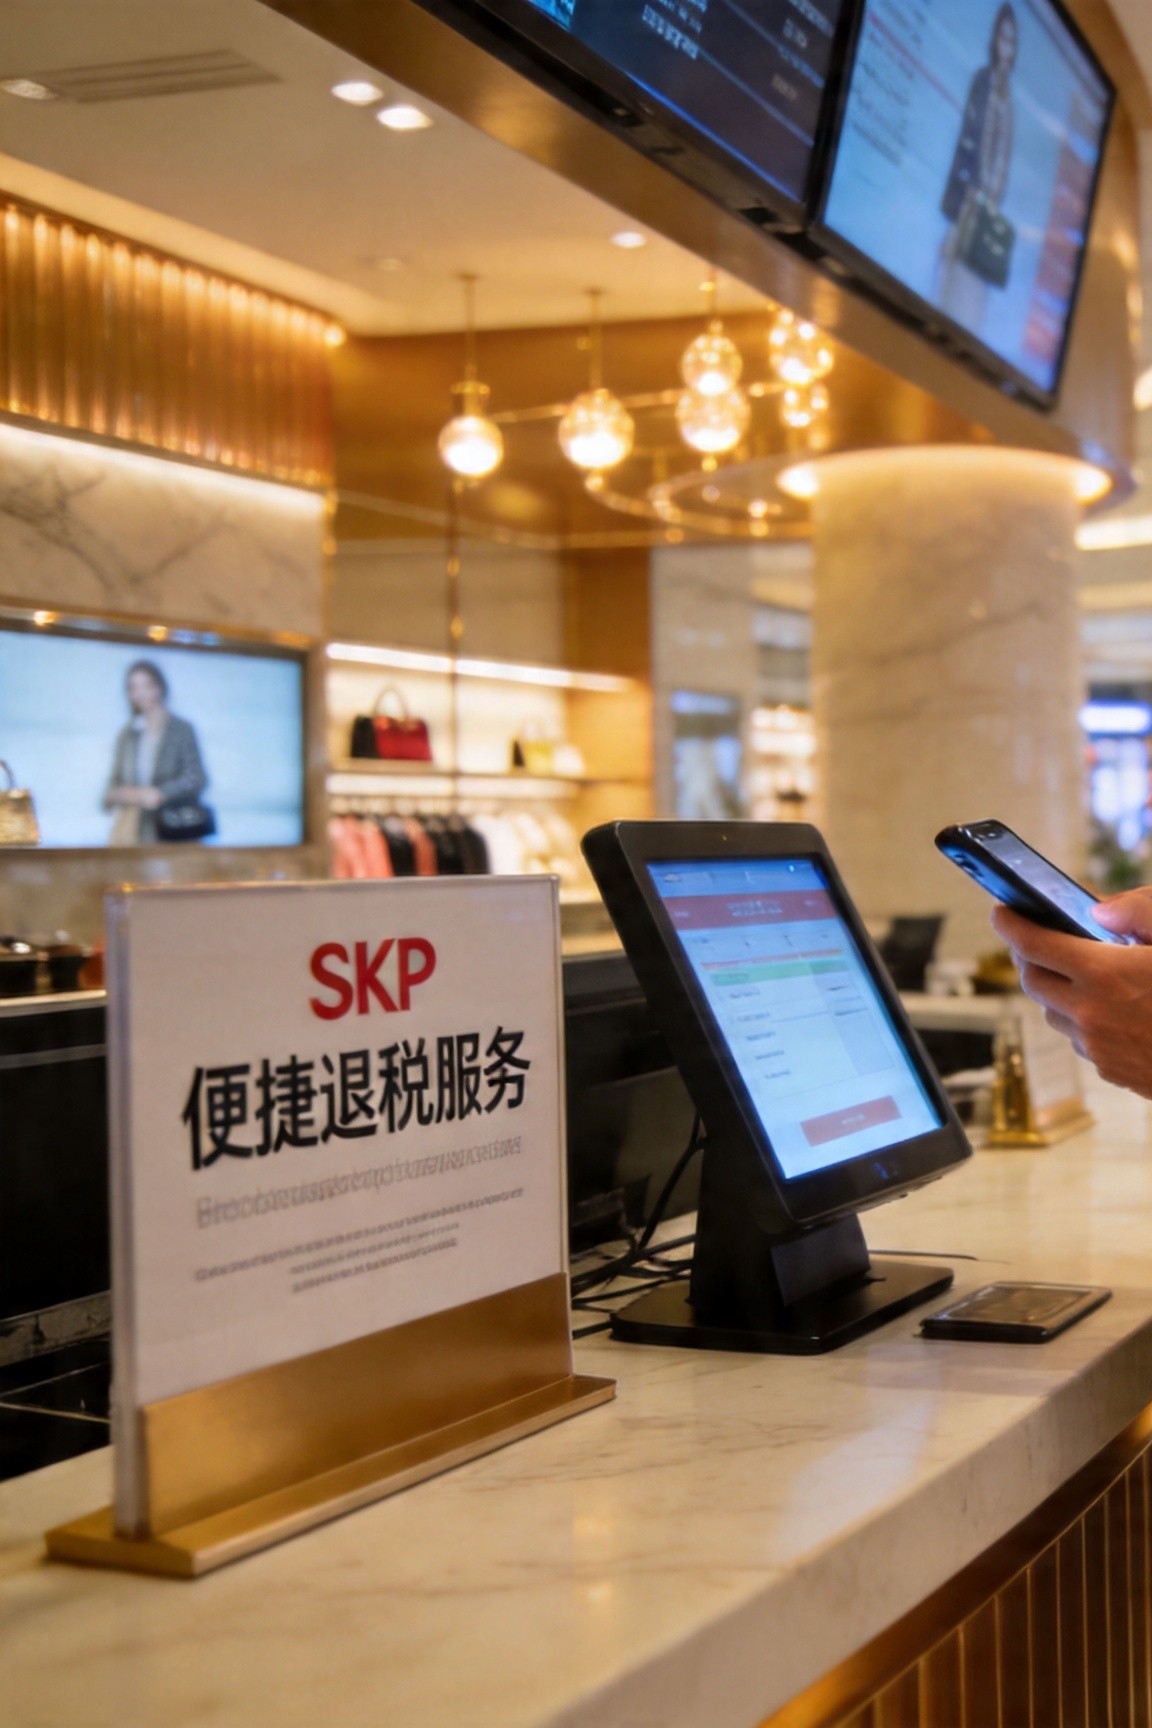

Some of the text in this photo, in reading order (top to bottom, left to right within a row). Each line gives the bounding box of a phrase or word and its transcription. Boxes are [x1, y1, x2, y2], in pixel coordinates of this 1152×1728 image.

[308, 937, 437, 1021] SKP
[182, 1026, 531, 1171] 便捷退税服务
